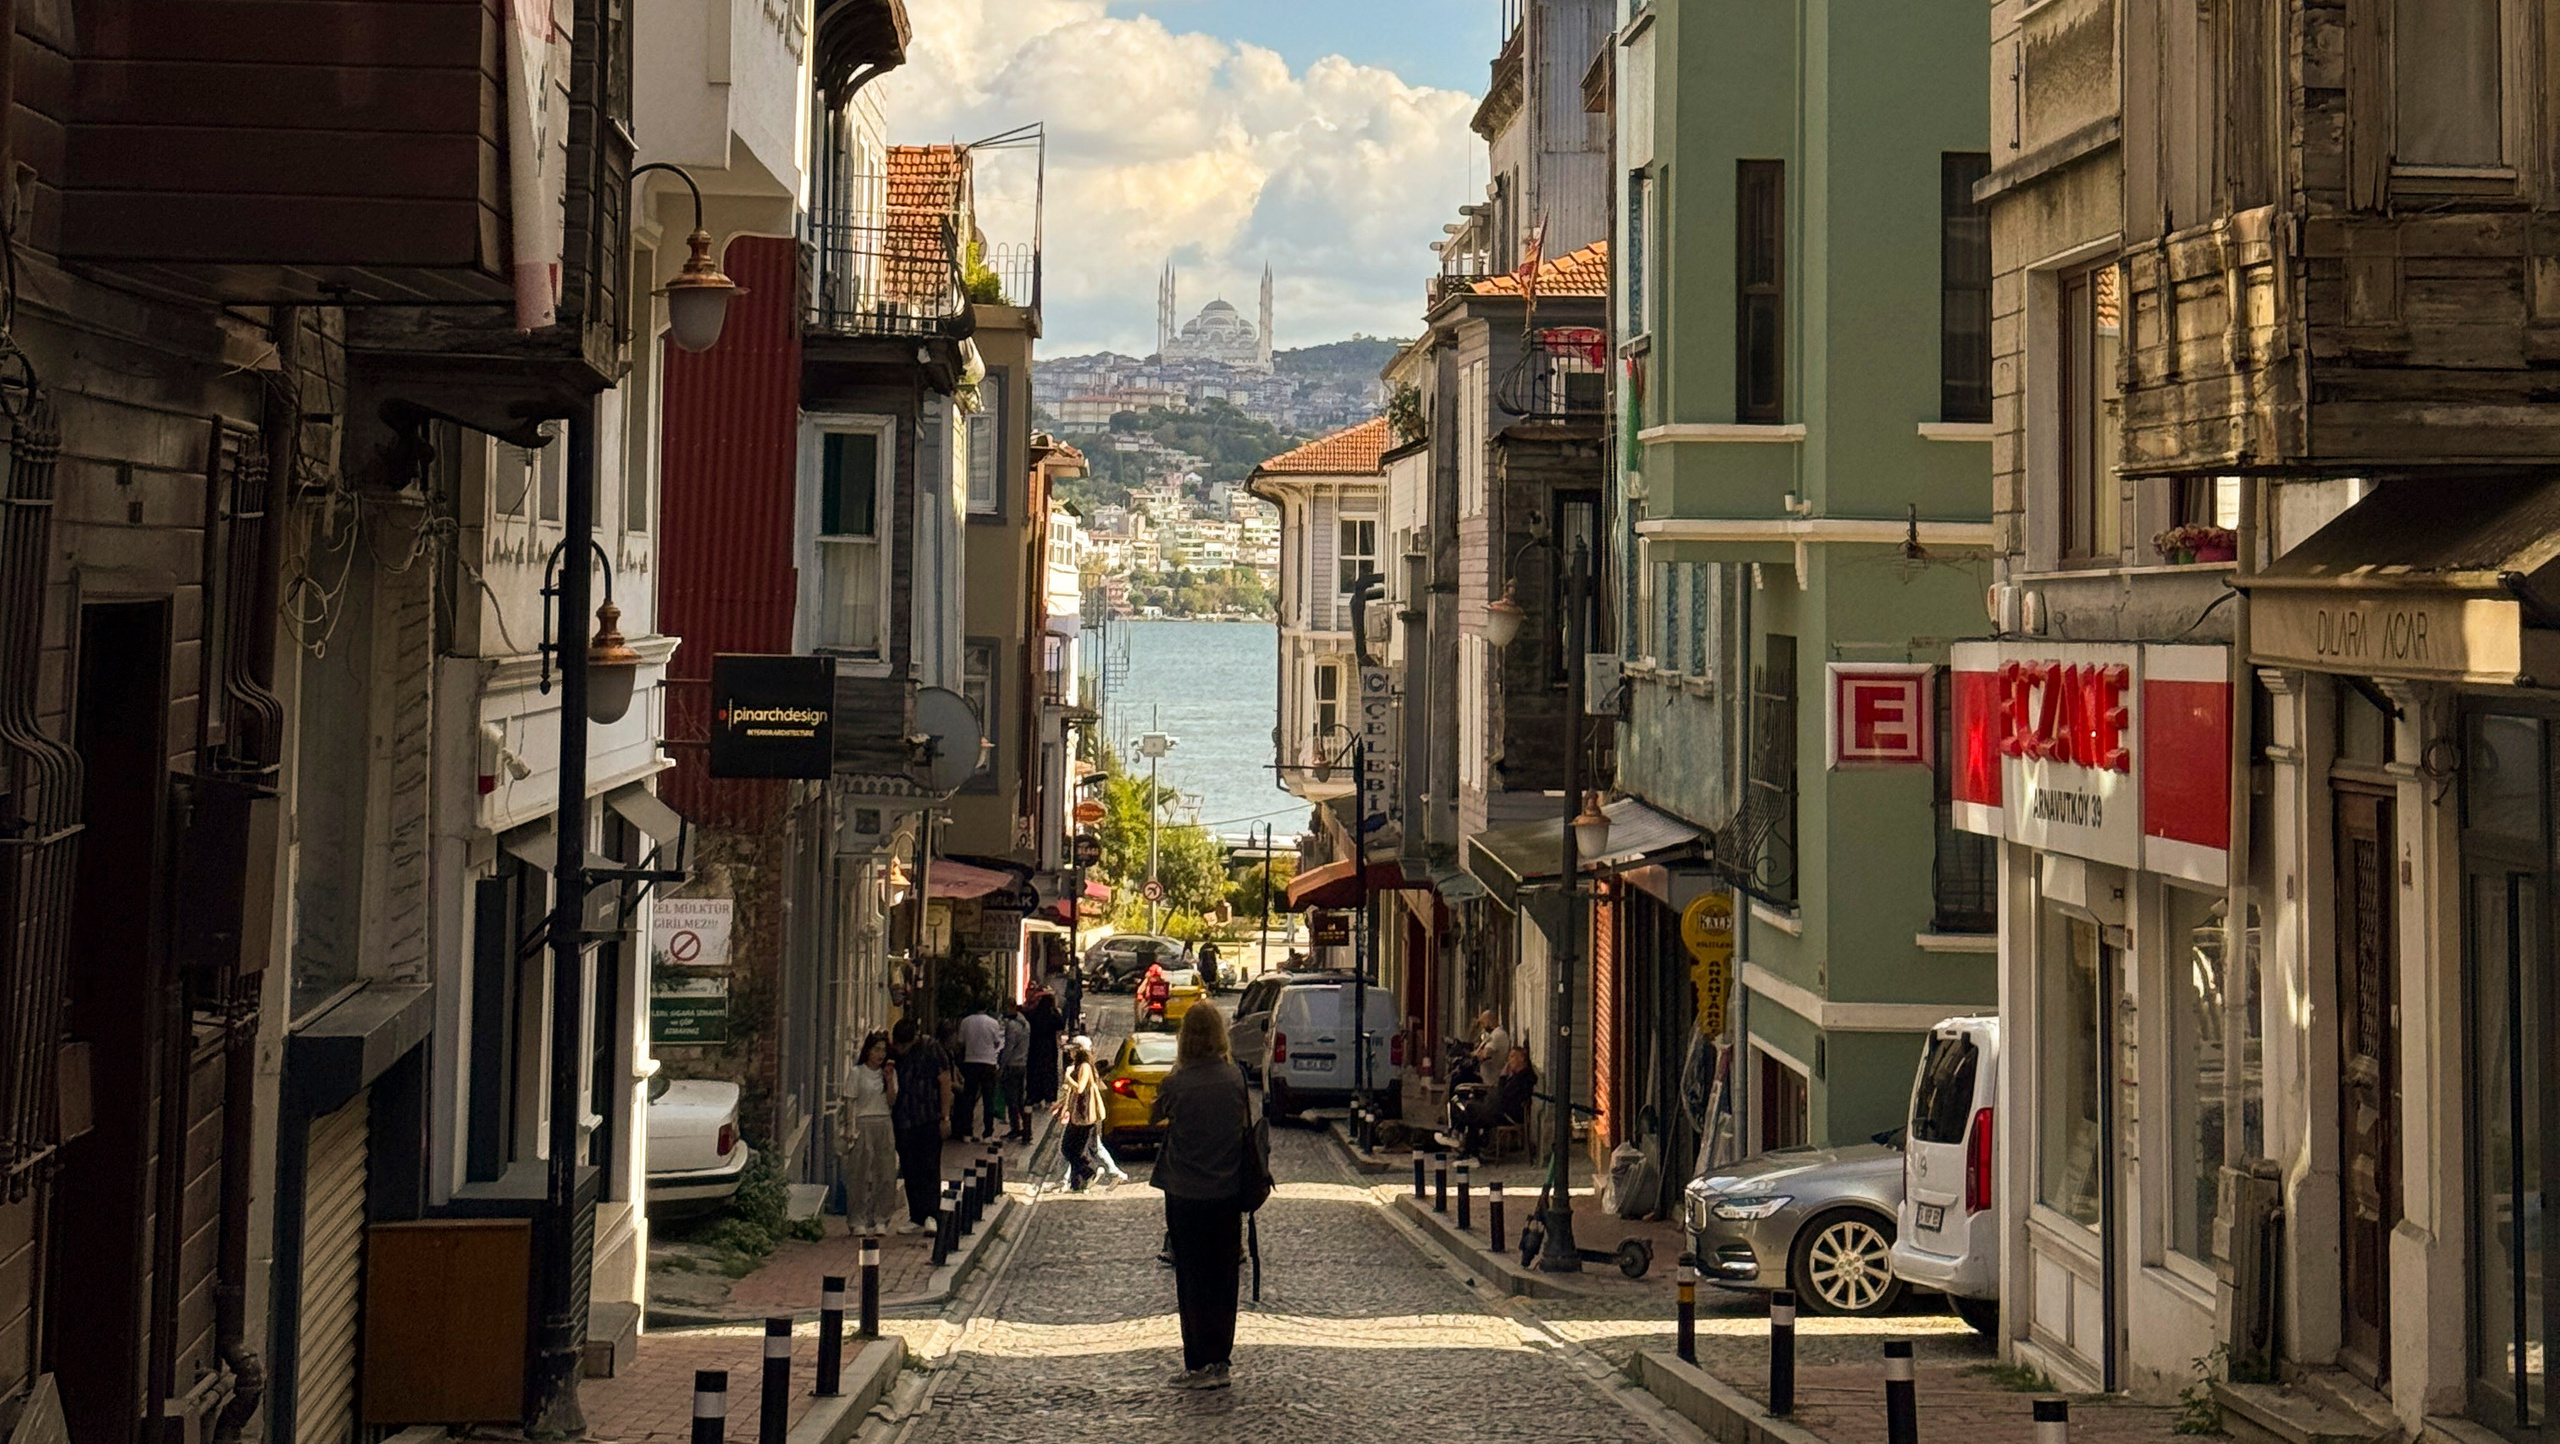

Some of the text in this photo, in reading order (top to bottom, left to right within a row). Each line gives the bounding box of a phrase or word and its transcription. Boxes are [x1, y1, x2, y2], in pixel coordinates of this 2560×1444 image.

[2383, 611, 2429, 660] ACAR
[733, 706, 828, 726] pinarchdesign
[1855, 686, 1908, 750] E
[1998, 659, 2130, 773] ECZANE
[1365, 703, 1387, 811] ÇELEBİ
[2033, 786, 2102, 828] ARNAVUTKÖY 39
[674, 902, 729, 914] MÜLKTÜR
